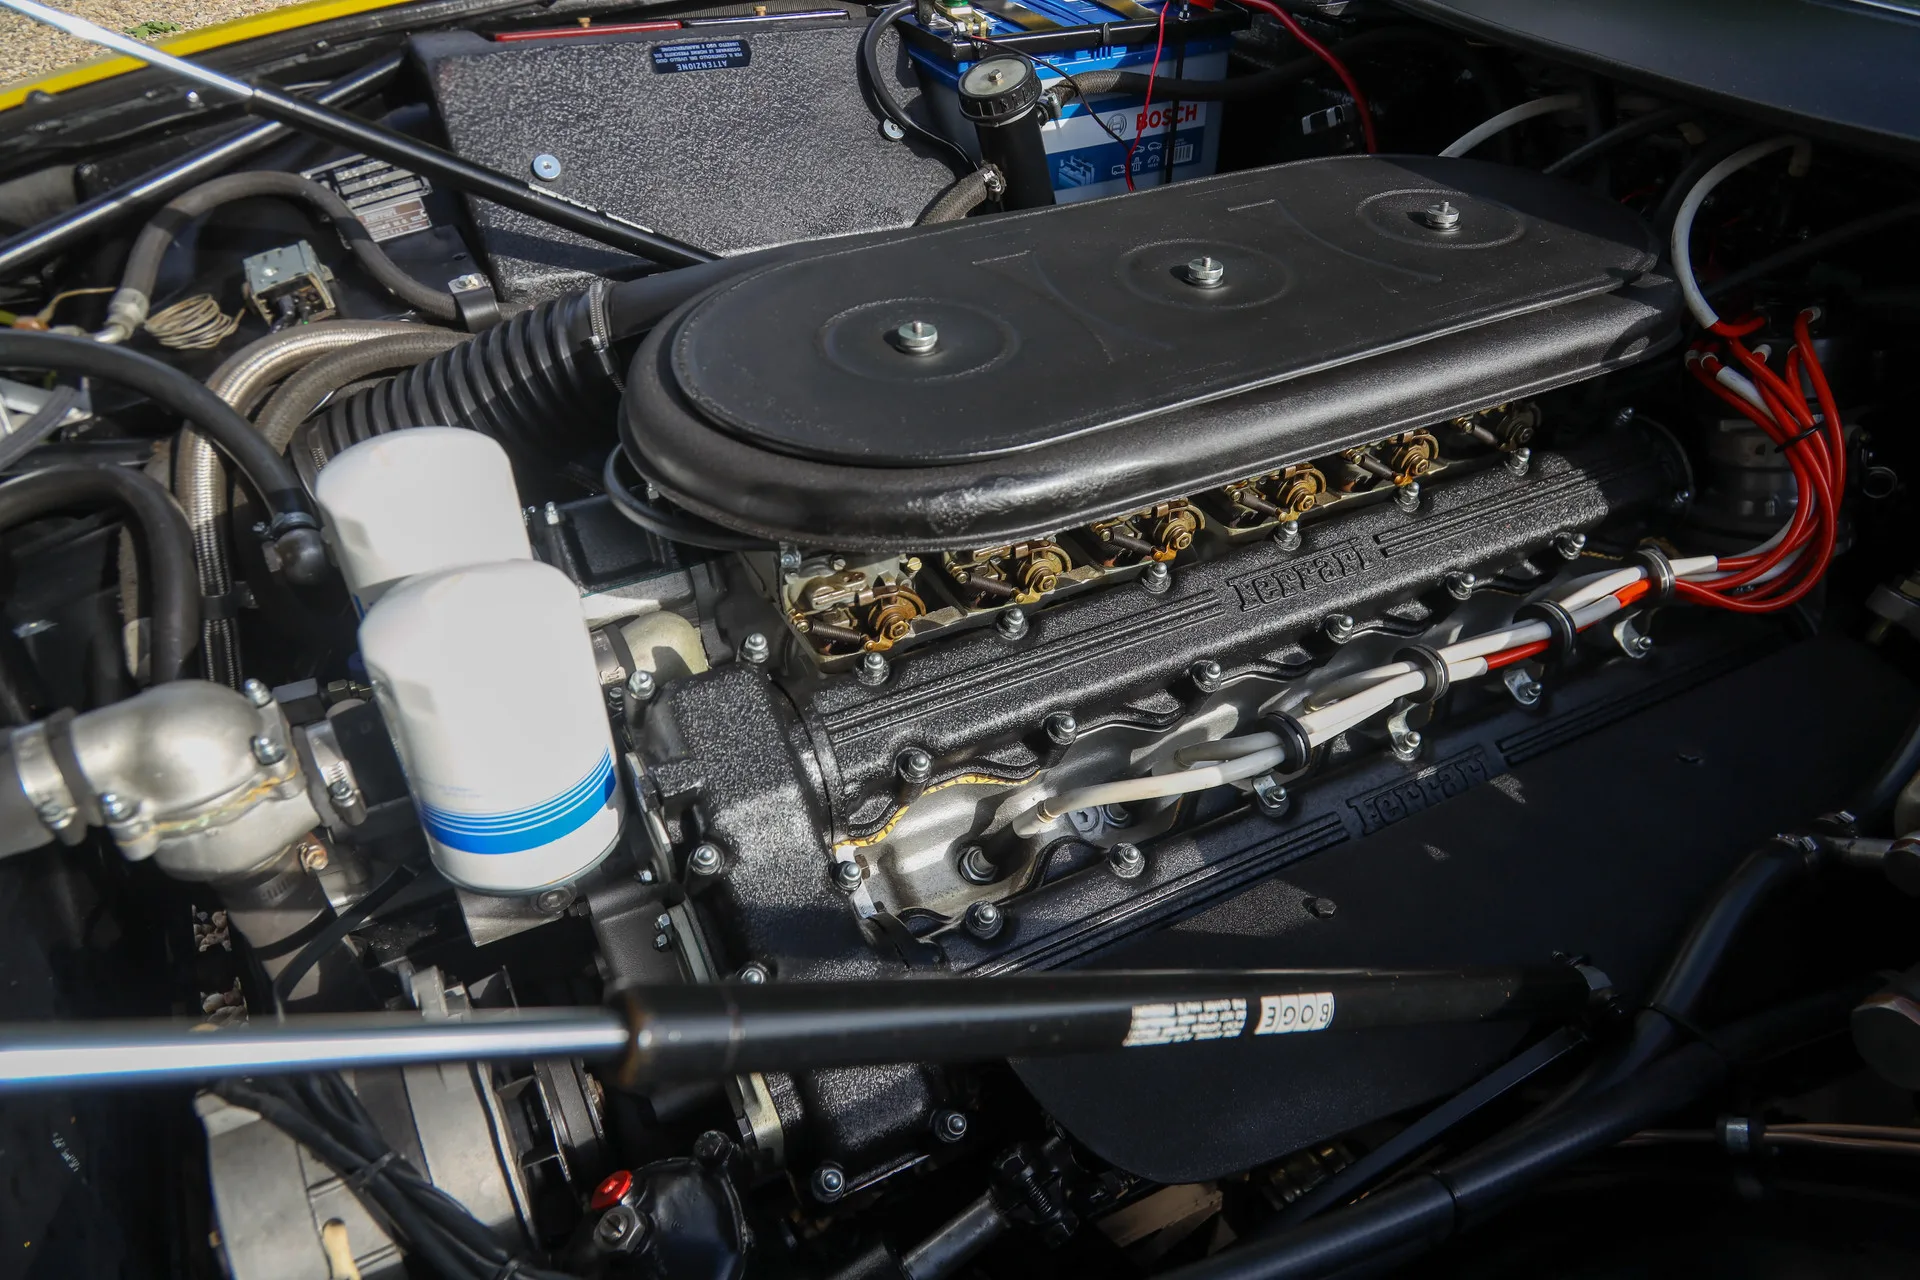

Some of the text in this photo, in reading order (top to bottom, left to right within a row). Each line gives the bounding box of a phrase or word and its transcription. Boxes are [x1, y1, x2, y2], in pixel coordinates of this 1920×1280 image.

[677, 60, 727, 71] ATTENZIONE
[1135, 104, 1197, 131] BOSCH
[1225, 536, 1376, 613] Ferrari
[1346, 743, 1492, 836] Ferrari
[1264, 1003, 1330, 1028] BOGE
